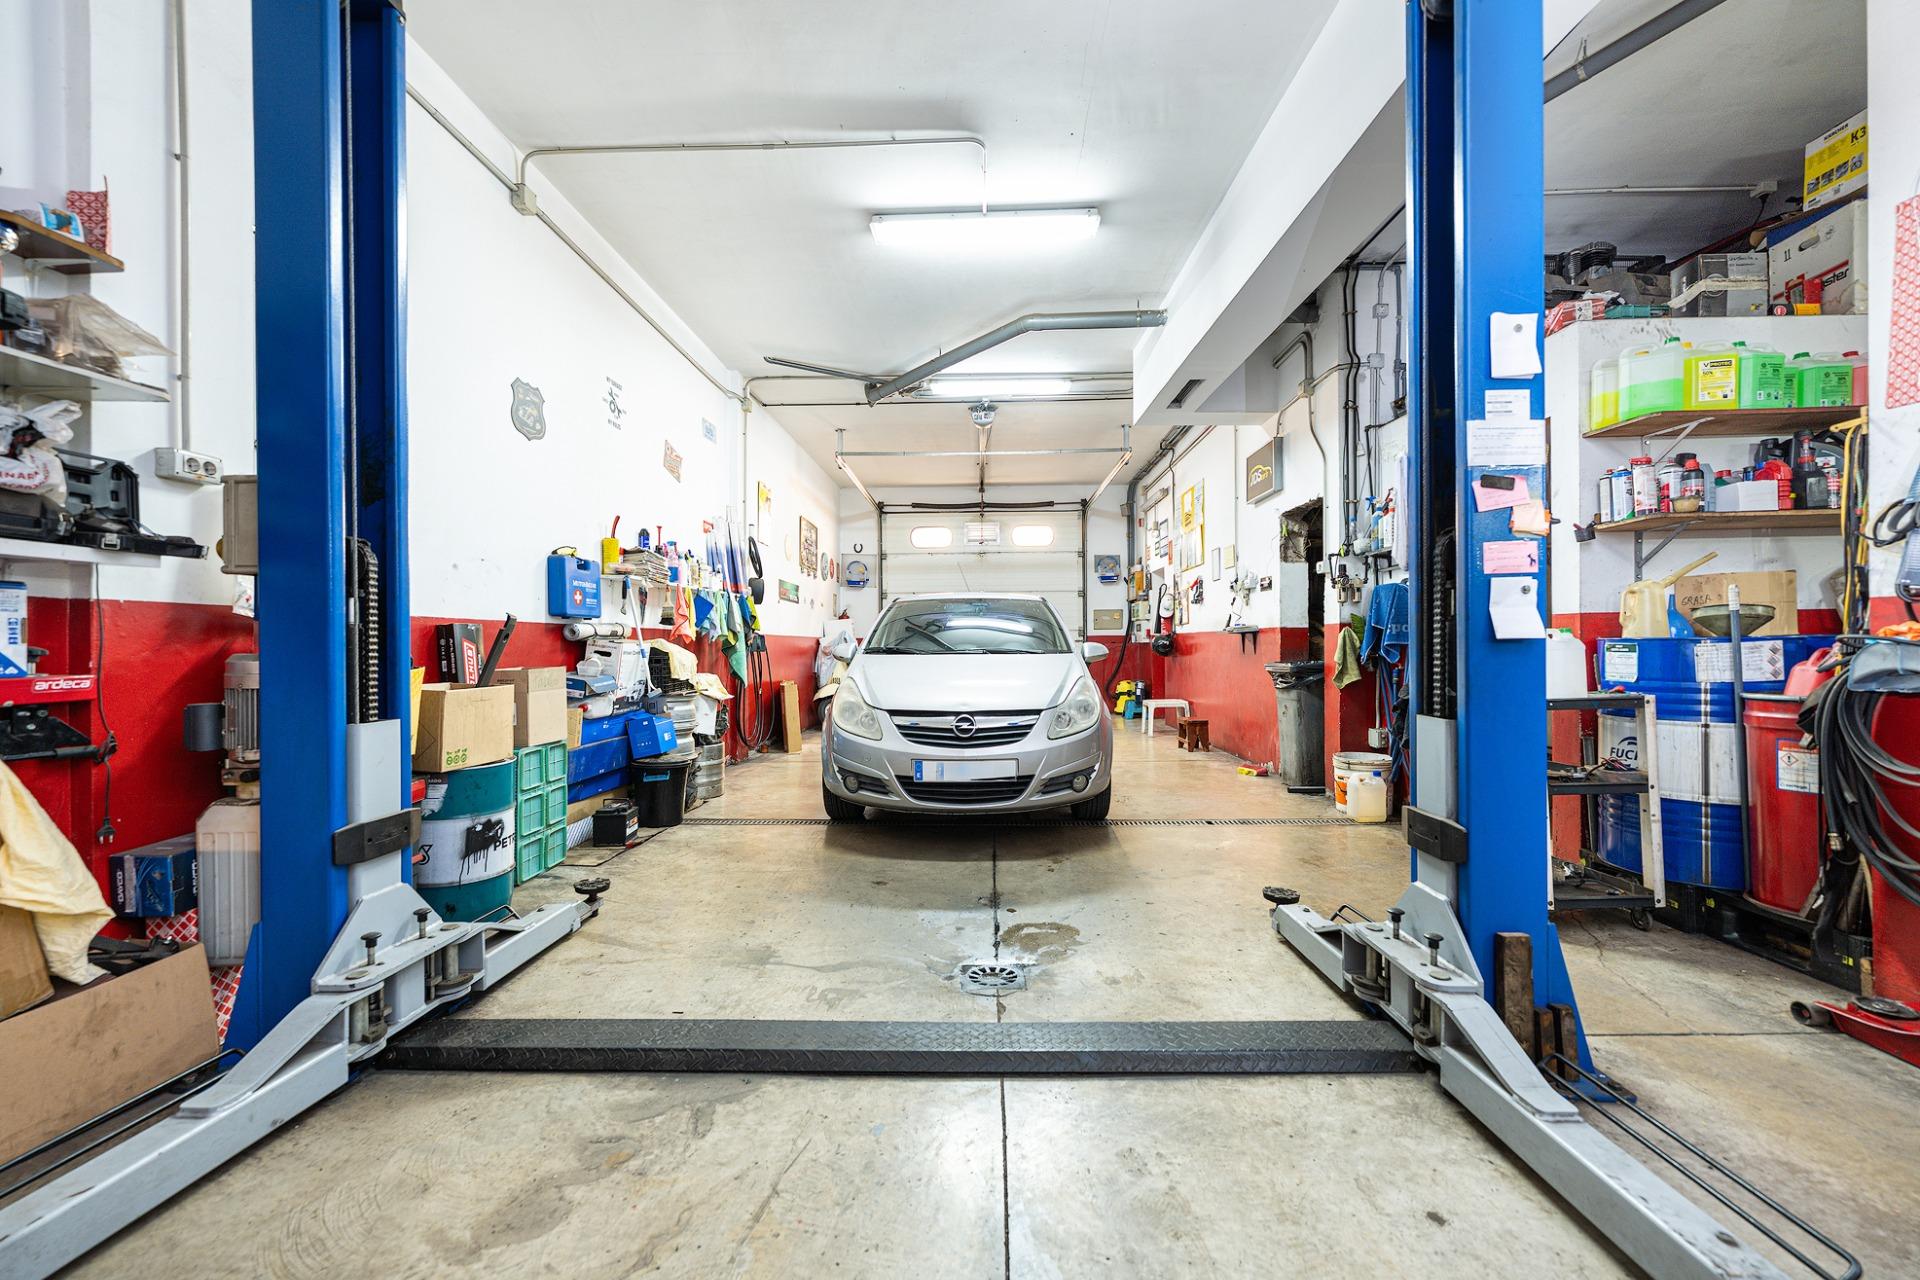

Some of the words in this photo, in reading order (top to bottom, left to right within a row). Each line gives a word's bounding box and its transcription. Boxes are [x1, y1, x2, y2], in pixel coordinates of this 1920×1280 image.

[1822, 268, 1850, 288] ster
[1681, 594, 1712, 606] GRASA
[34, 679, 91, 691] ardeca
